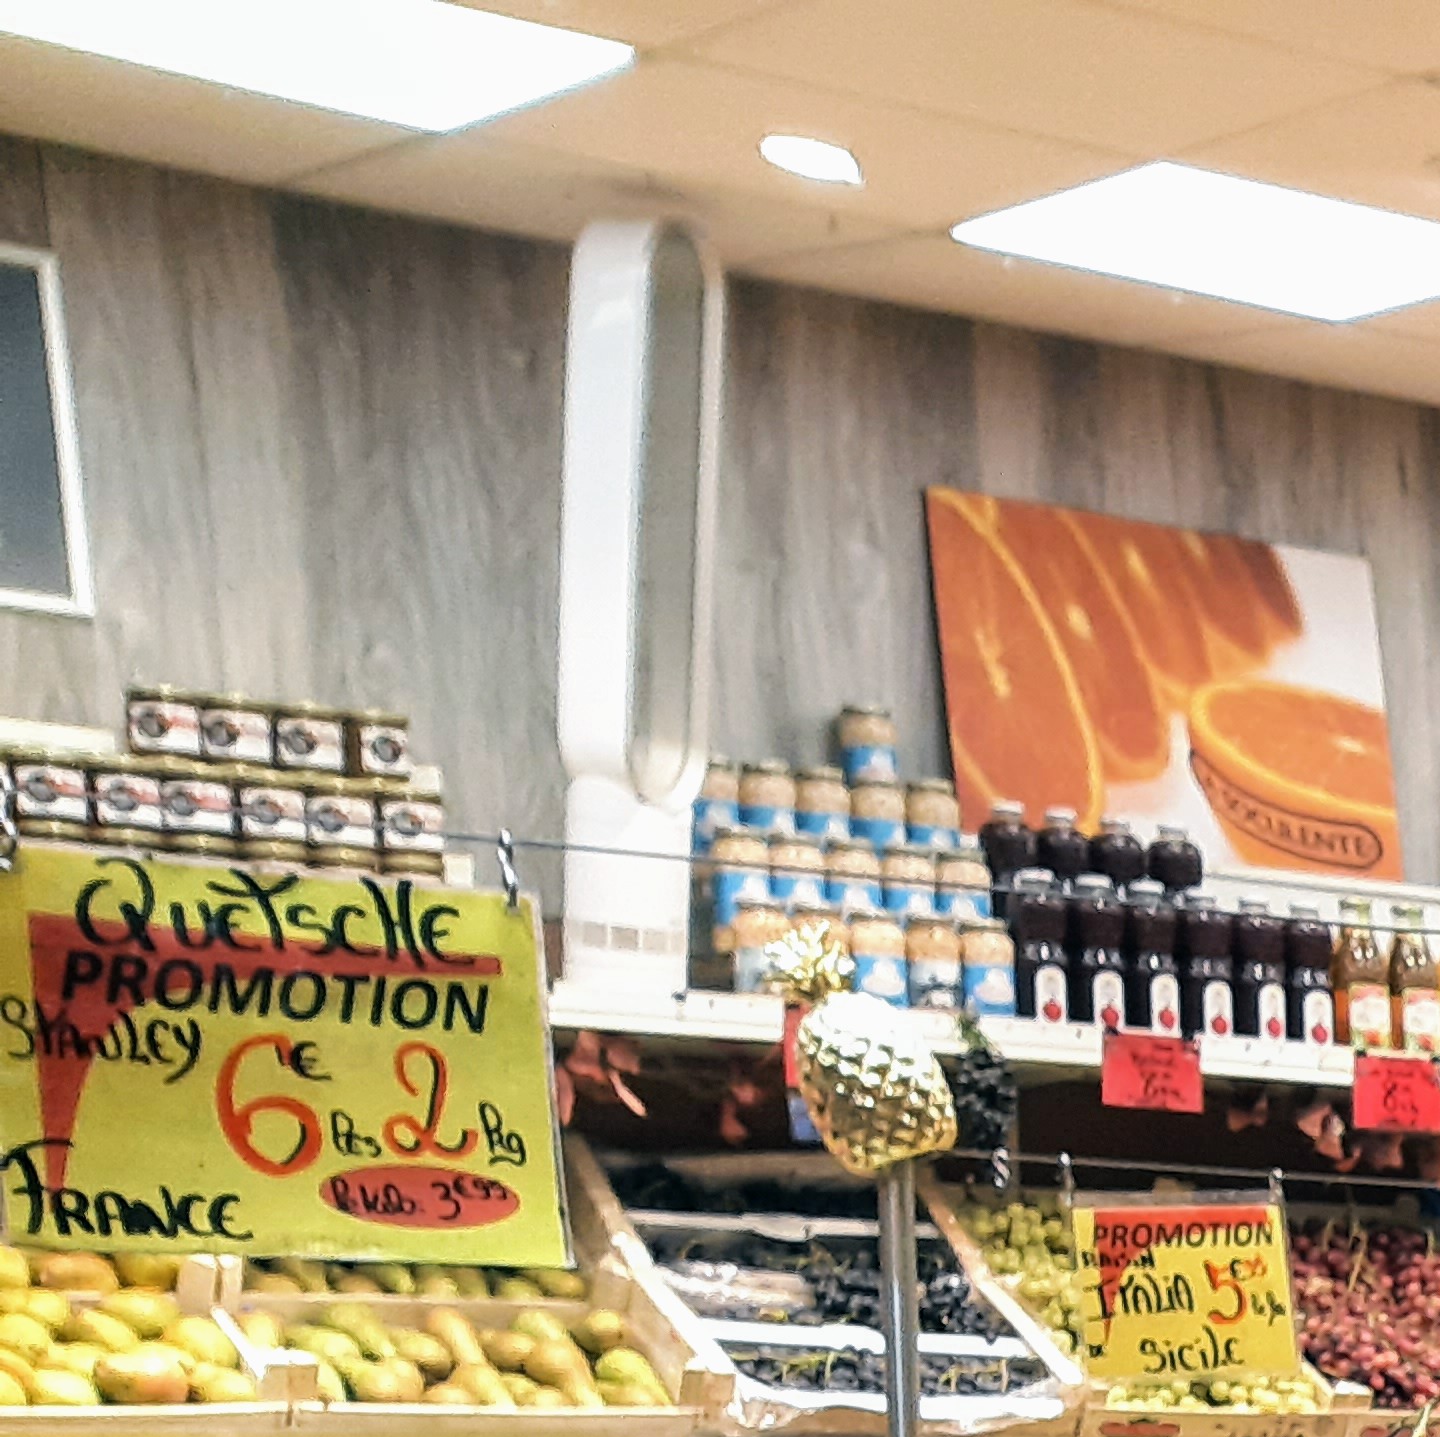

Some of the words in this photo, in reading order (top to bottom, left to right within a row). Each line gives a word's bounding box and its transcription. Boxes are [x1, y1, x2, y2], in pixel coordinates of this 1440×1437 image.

[62, 950, 490, 1032] PROMOTION
[382, 1041, 478, 1159] 2
[0, 1139, 253, 1241] FRANCE
[1094, 1221, 1272, 1248] PROMOTION
